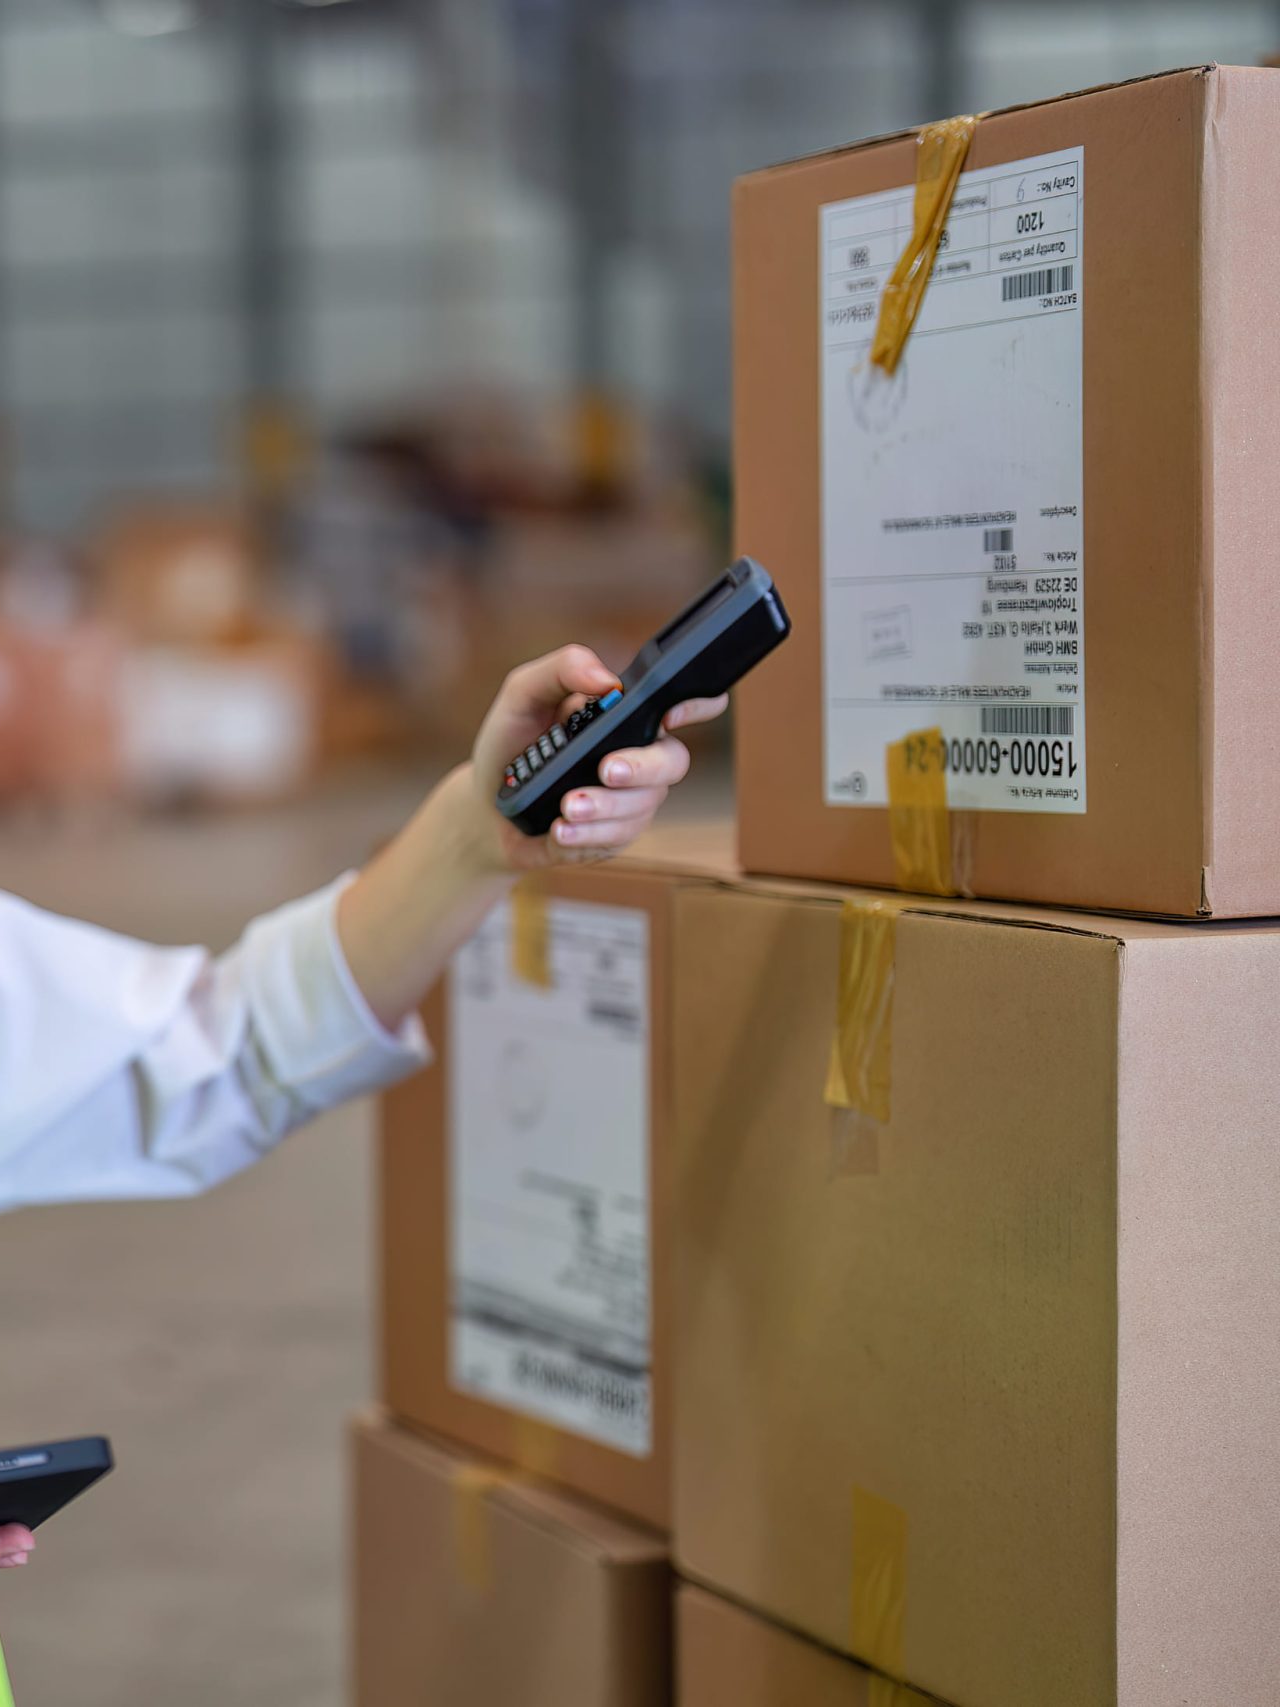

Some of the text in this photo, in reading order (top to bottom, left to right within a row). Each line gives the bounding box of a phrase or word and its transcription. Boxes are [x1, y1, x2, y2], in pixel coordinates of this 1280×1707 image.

[1053, 176, 1075, 191] Cavity
[1016, 211, 1044, 234] 1200
[999, 241, 1065, 262] Quantity per Carton
[1054, 293, 1077, 306] BATCH
[1058, 551, 1077, 562] Article
[987, 576, 1027, 594] Hamburg
[1064, 577, 1077, 592] DE
[1055, 620, 1078, 634] Werk
[1024, 640, 1077, 656] BMH GmbH
